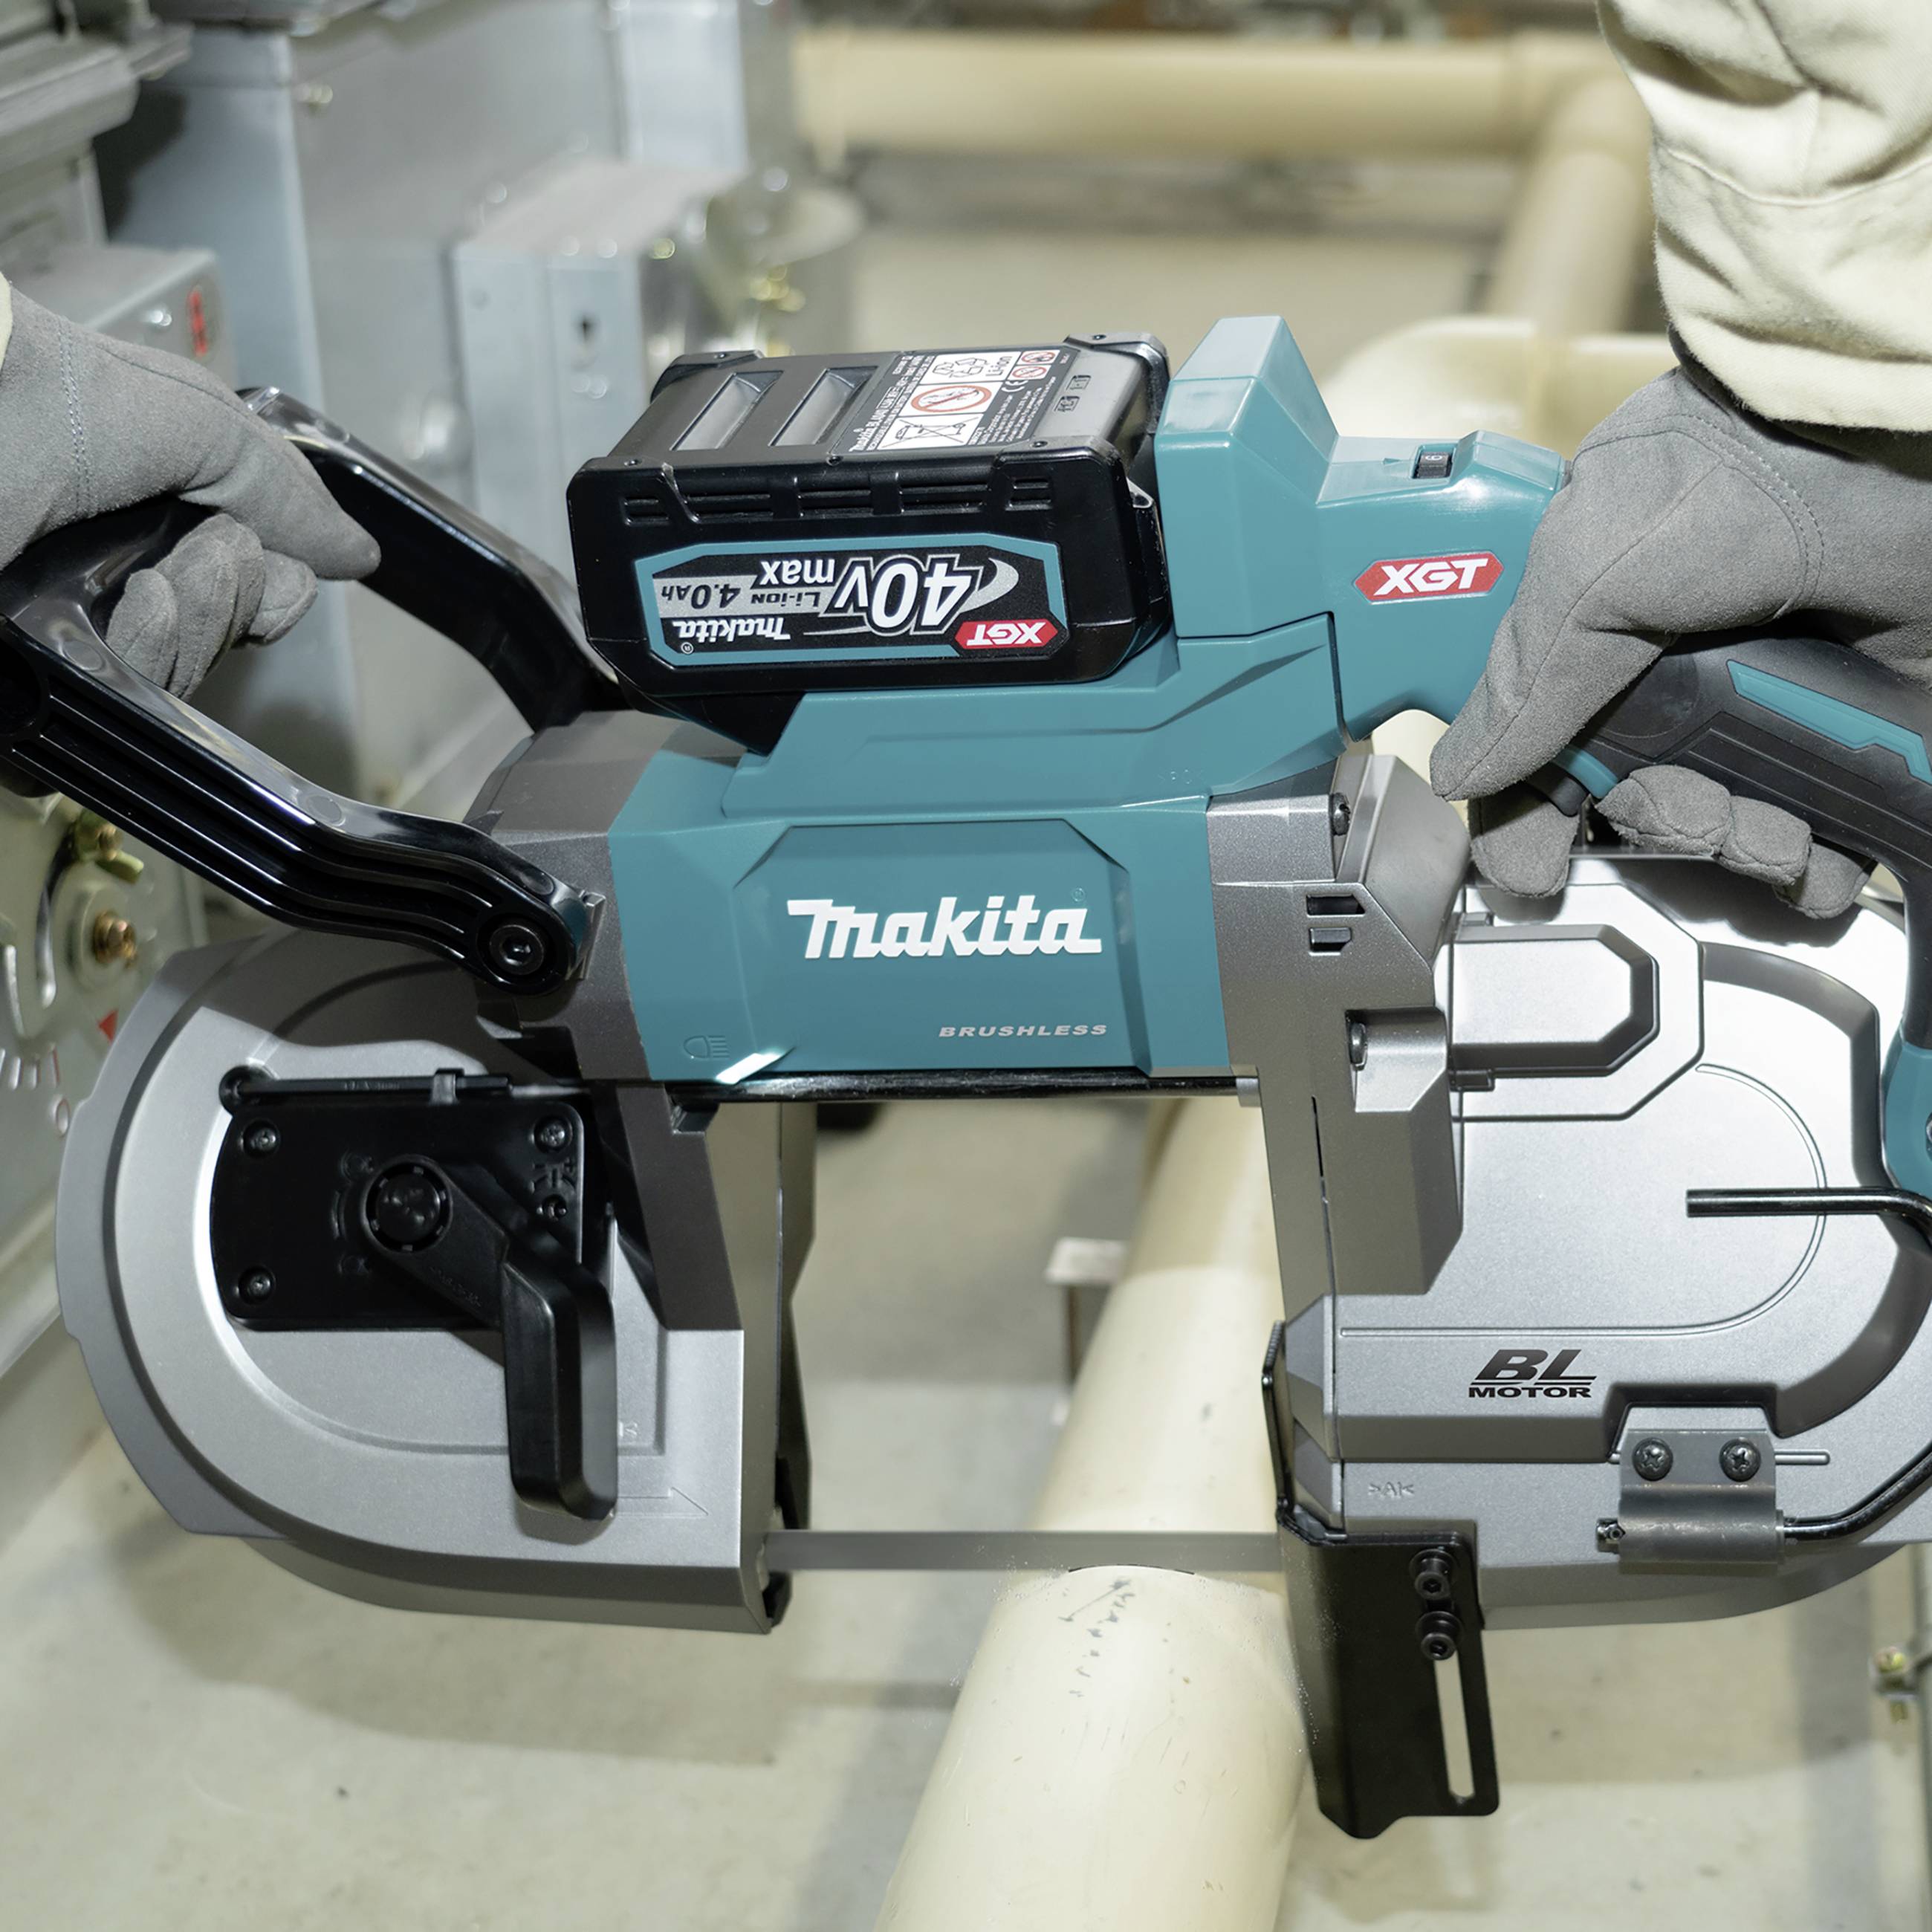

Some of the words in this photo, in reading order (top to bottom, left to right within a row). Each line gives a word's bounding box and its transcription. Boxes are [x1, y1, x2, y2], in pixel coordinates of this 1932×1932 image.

[1002, 380, 1028, 392] CE
[759, 559, 835, 586] max
[1373, 558, 1488, 596] XGT
[661, 583, 741, 609] 4.0Ah
[833, 563, 972, 629] 40V
[966, 622, 1046, 646] XGT
[939, 1024, 1107, 1038] BRUSHLESS
[1474, 1349, 1597, 1381] BL
[1468, 1387, 1592, 1398] MOTOR
